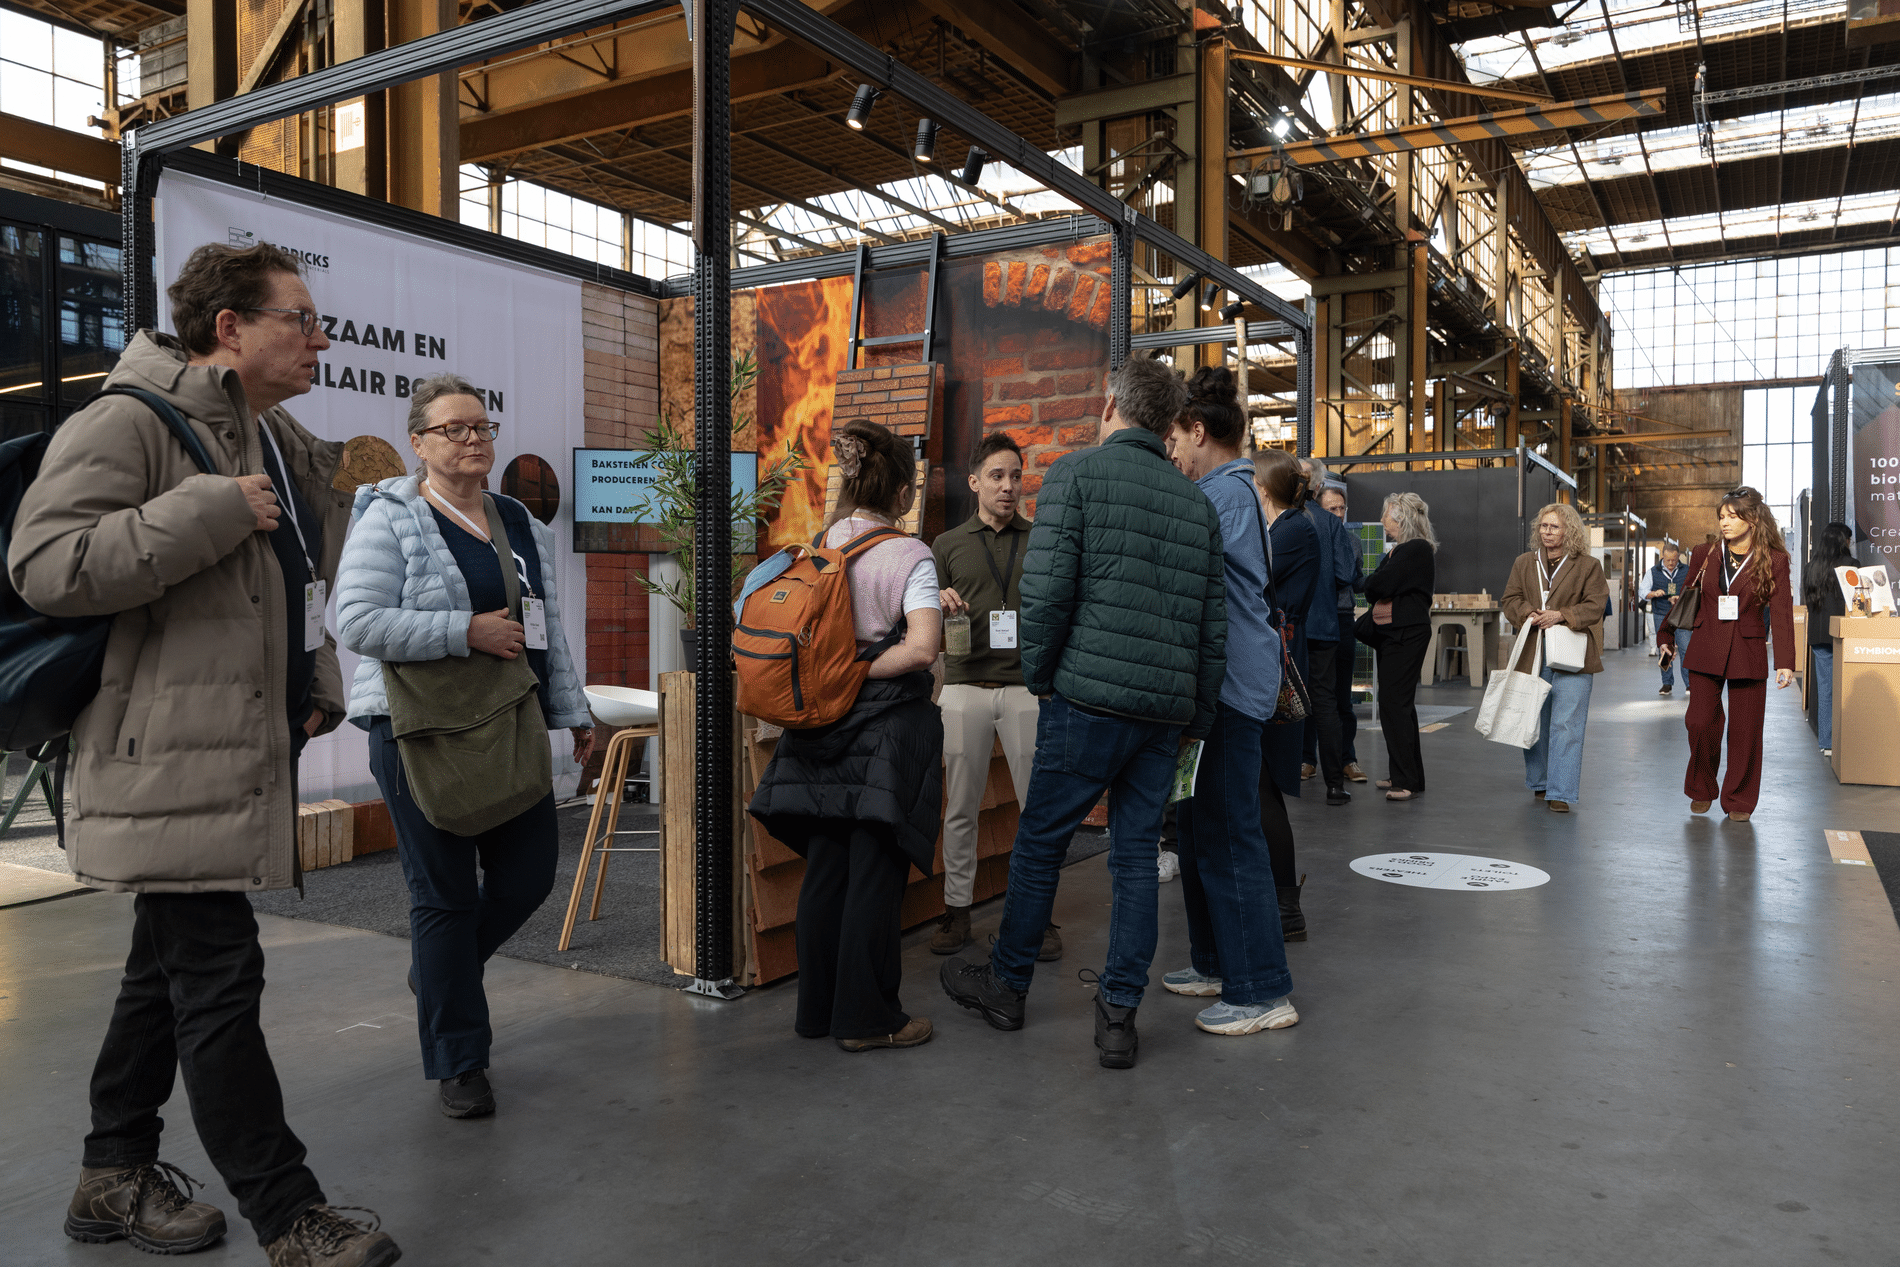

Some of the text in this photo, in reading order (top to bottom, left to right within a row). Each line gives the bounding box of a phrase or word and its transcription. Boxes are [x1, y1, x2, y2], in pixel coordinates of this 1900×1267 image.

[322, 314, 446, 360] ZAAM EN
[592, 460, 648, 469] BAKSTENEN
[592, 476, 656, 484] PRODUCEREN
[1870, 473, 1900, 485] bio
[592, 506, 613, 514] KAN
[1869, 526, 1900, 538] Cre
[1470, 868, 1518, 876] TOILETS
